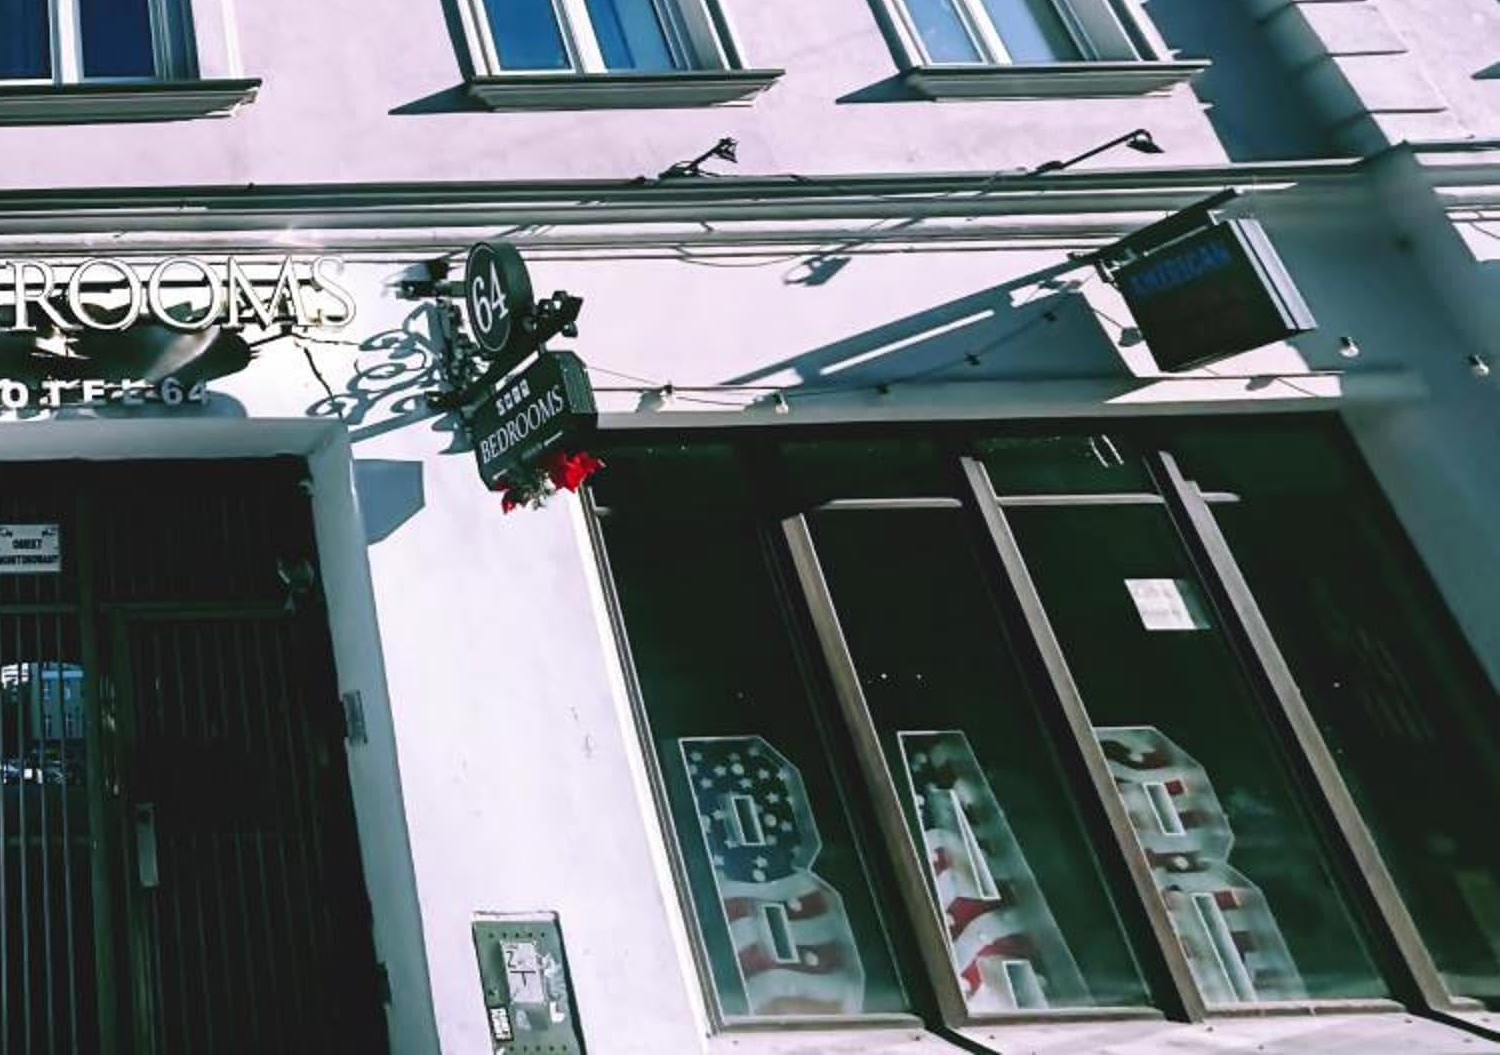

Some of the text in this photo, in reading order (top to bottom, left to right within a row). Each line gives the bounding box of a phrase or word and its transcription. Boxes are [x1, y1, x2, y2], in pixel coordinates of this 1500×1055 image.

[473, 261, 509, 334] 64
[160, 377, 207, 406] 64
[479, 384, 565, 465] BEDROOMS
